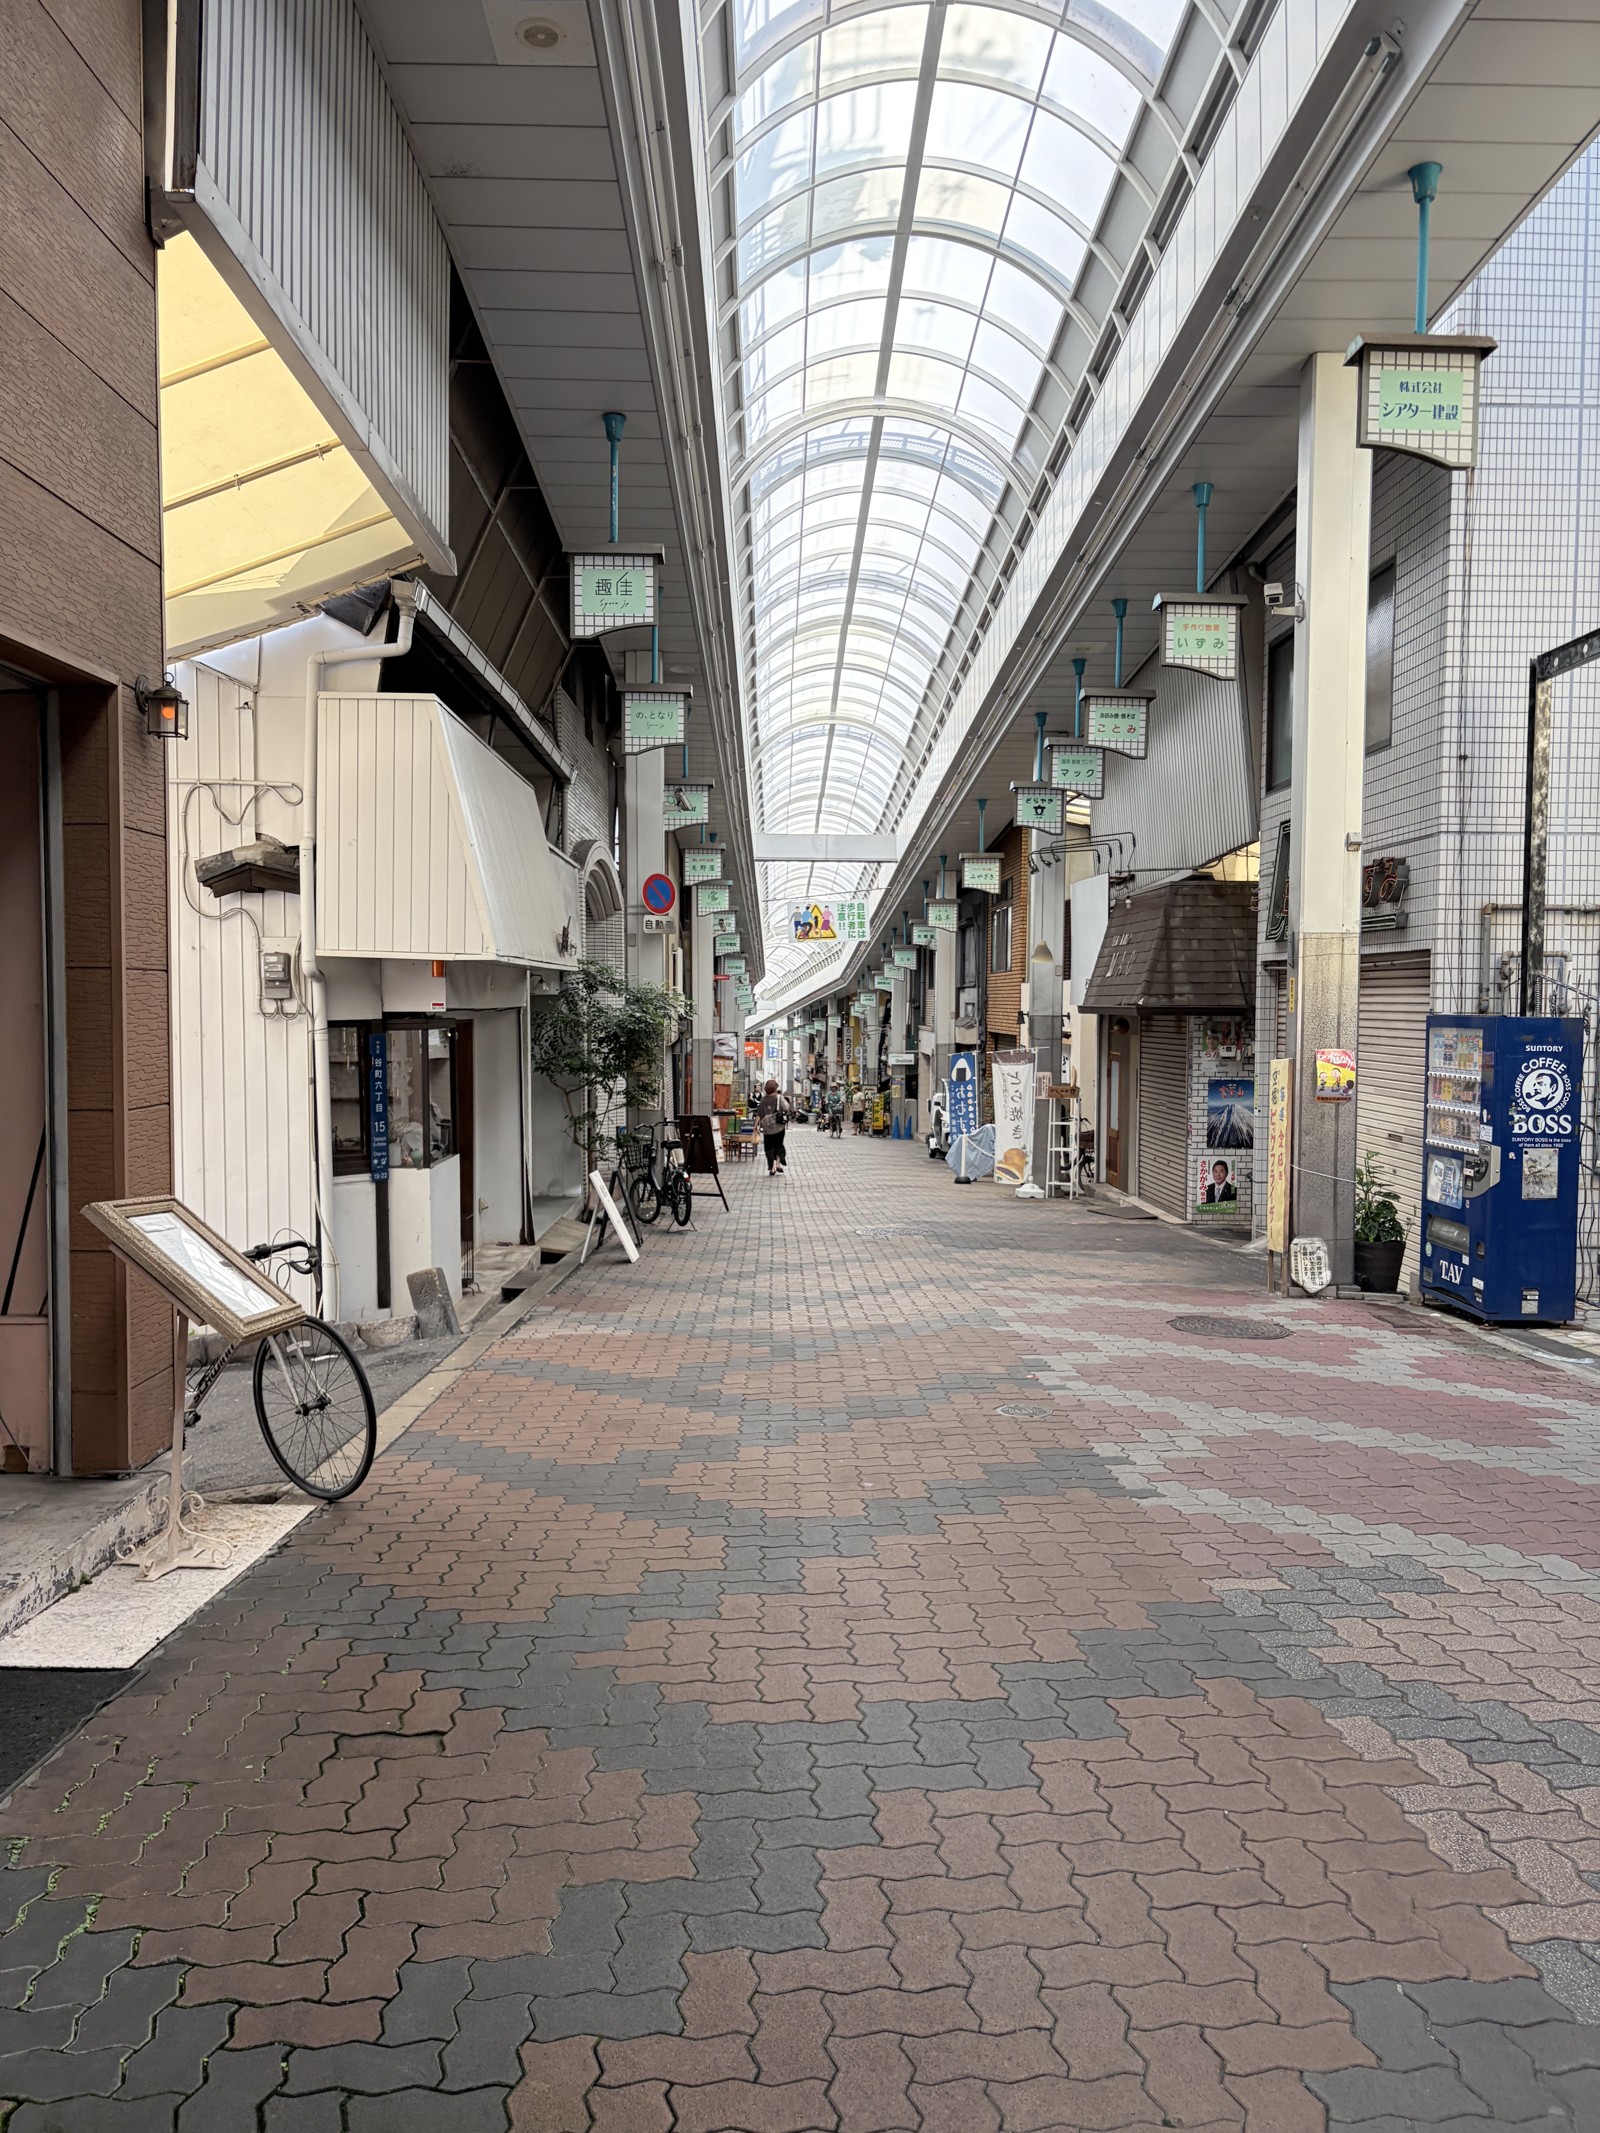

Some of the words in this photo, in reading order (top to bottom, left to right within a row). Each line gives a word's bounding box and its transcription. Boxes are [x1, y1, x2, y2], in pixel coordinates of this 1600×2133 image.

[1399, 381, 1443, 394] 株式会社
[1382, 402, 1459, 420] シアター建設
[595, 572, 633, 596] 趣佳
[1177, 638, 1225, 649] いずみ
[1097, 724, 1137, 734] ことみ
[1060, 769, 1095, 778] マック
[846, 902, 857, 939] 歩行者に
[856, 902, 867, 939] 自転車は
[1525, 1044, 1564, 1053] SUNTORY
[1521, 1057, 1567, 1074] COFFEE
[374, 1058, 383, 1112] 谷町六丁目
[374, 1121, 386, 1132] 15
[1511, 1114, 1572, 1135] BOSS
